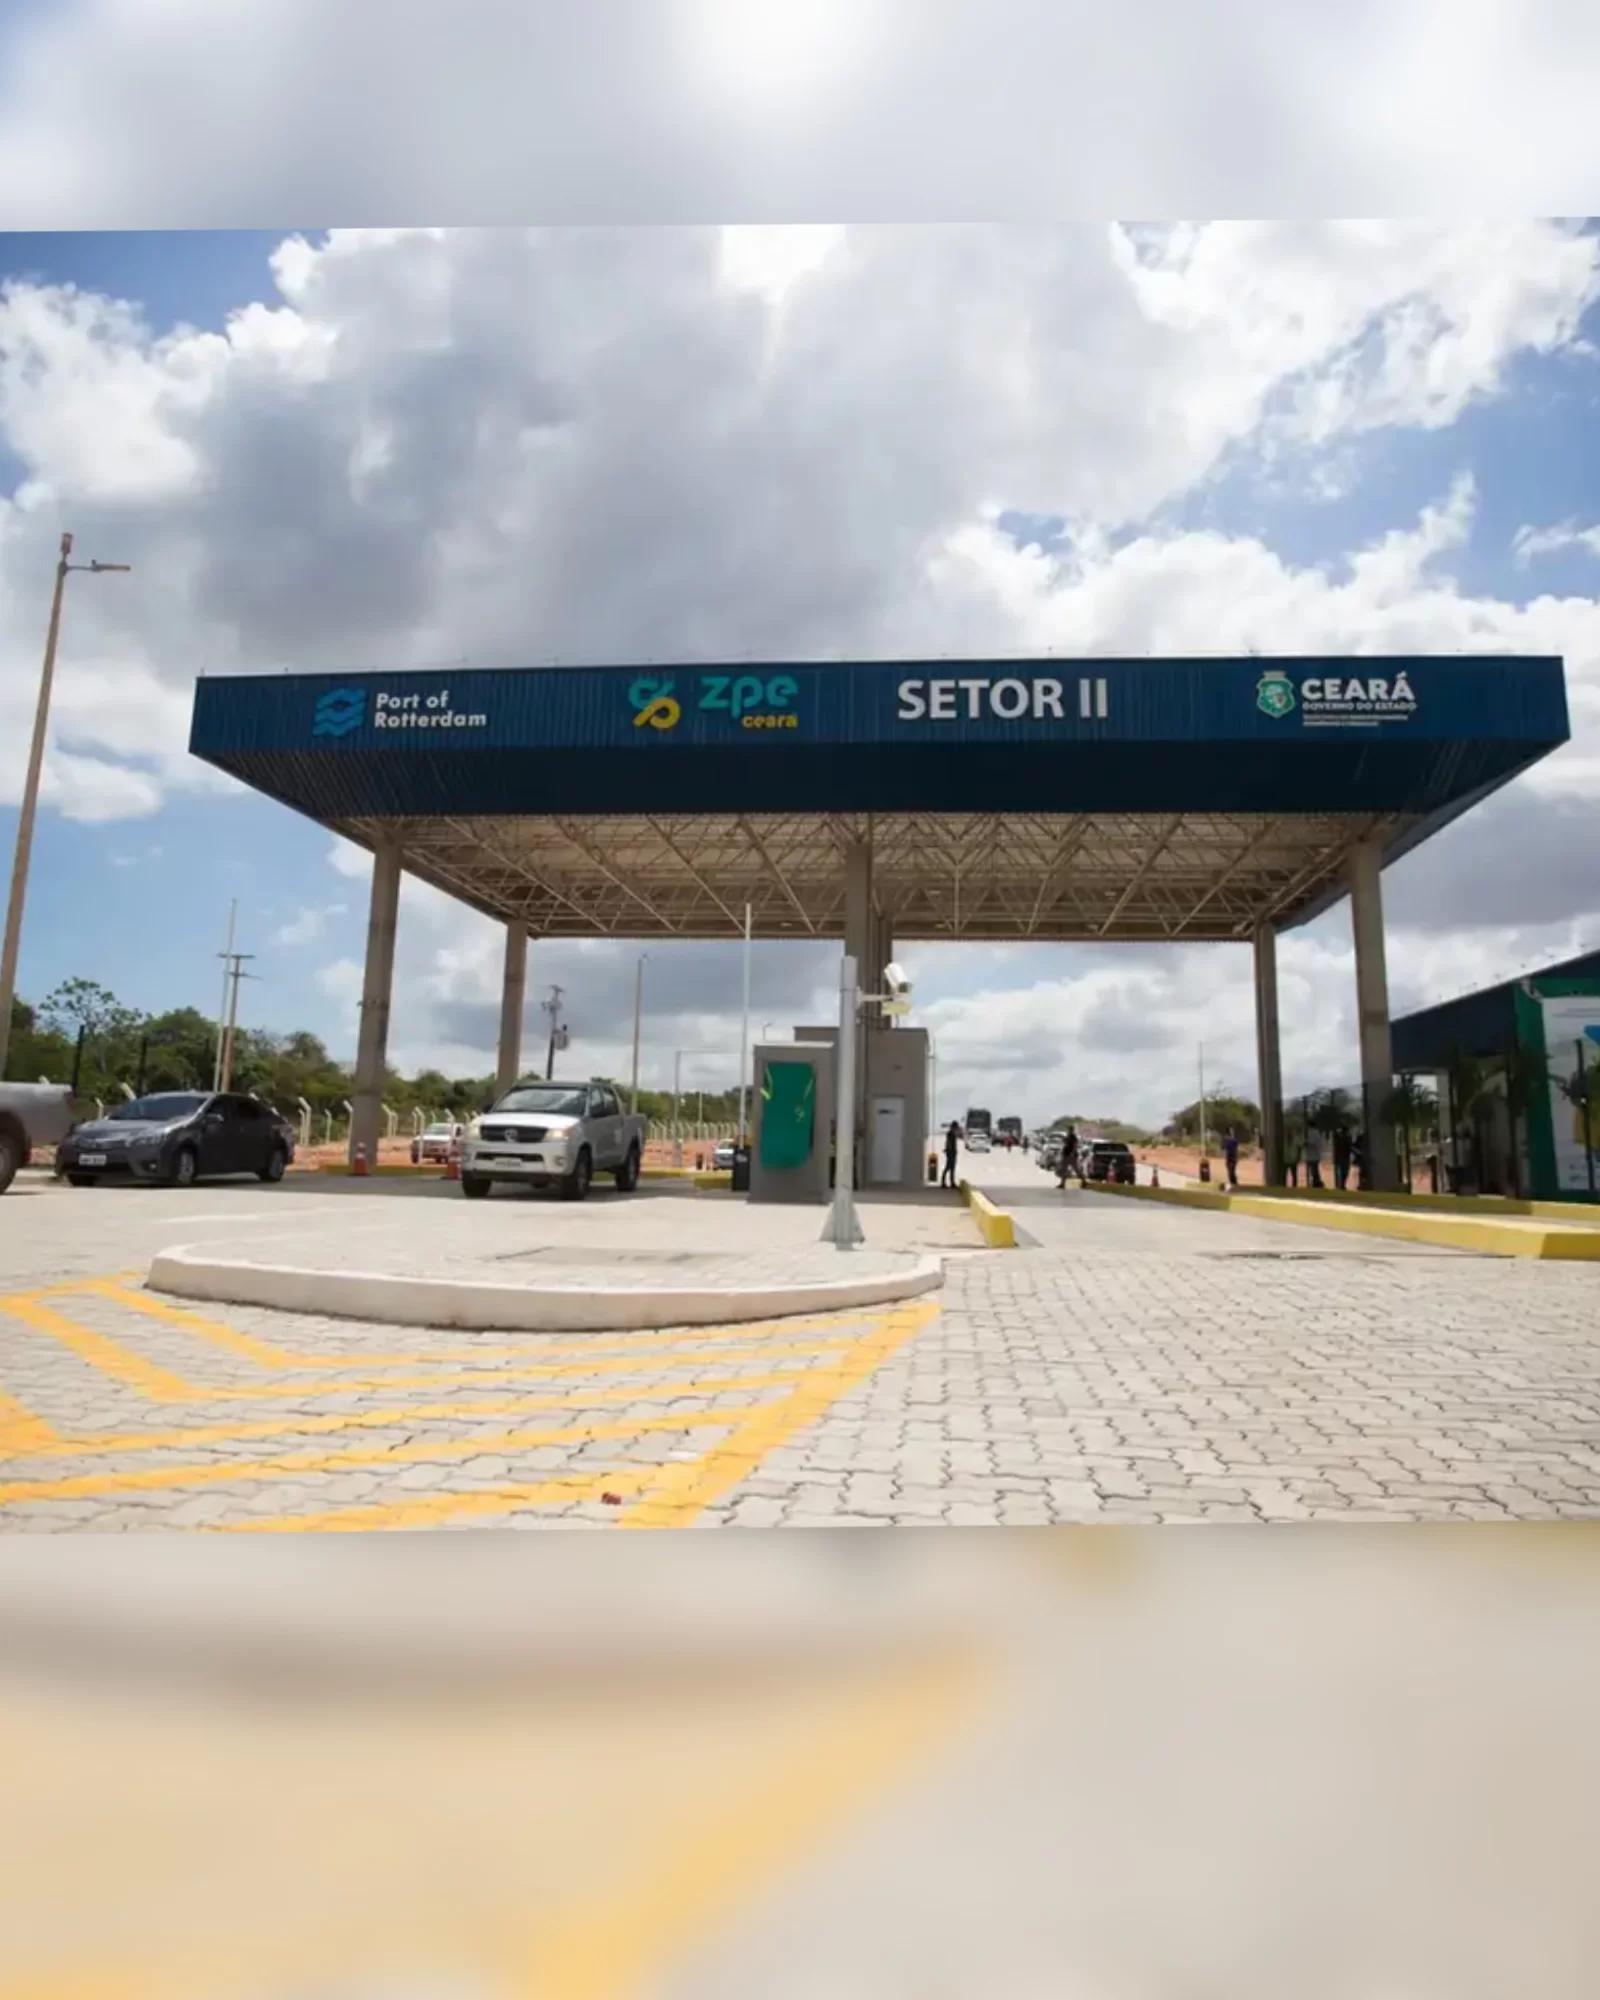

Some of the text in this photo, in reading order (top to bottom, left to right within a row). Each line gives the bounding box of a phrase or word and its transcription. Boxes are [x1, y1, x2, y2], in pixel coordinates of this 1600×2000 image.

[376, 690, 449, 709] Port of
[699, 676, 798, 718] zpe
[898, 678, 1108, 720] SETOR II
[1301, 671, 1415, 701] CEARÁ
[374, 710, 487, 728] Rotterdam
